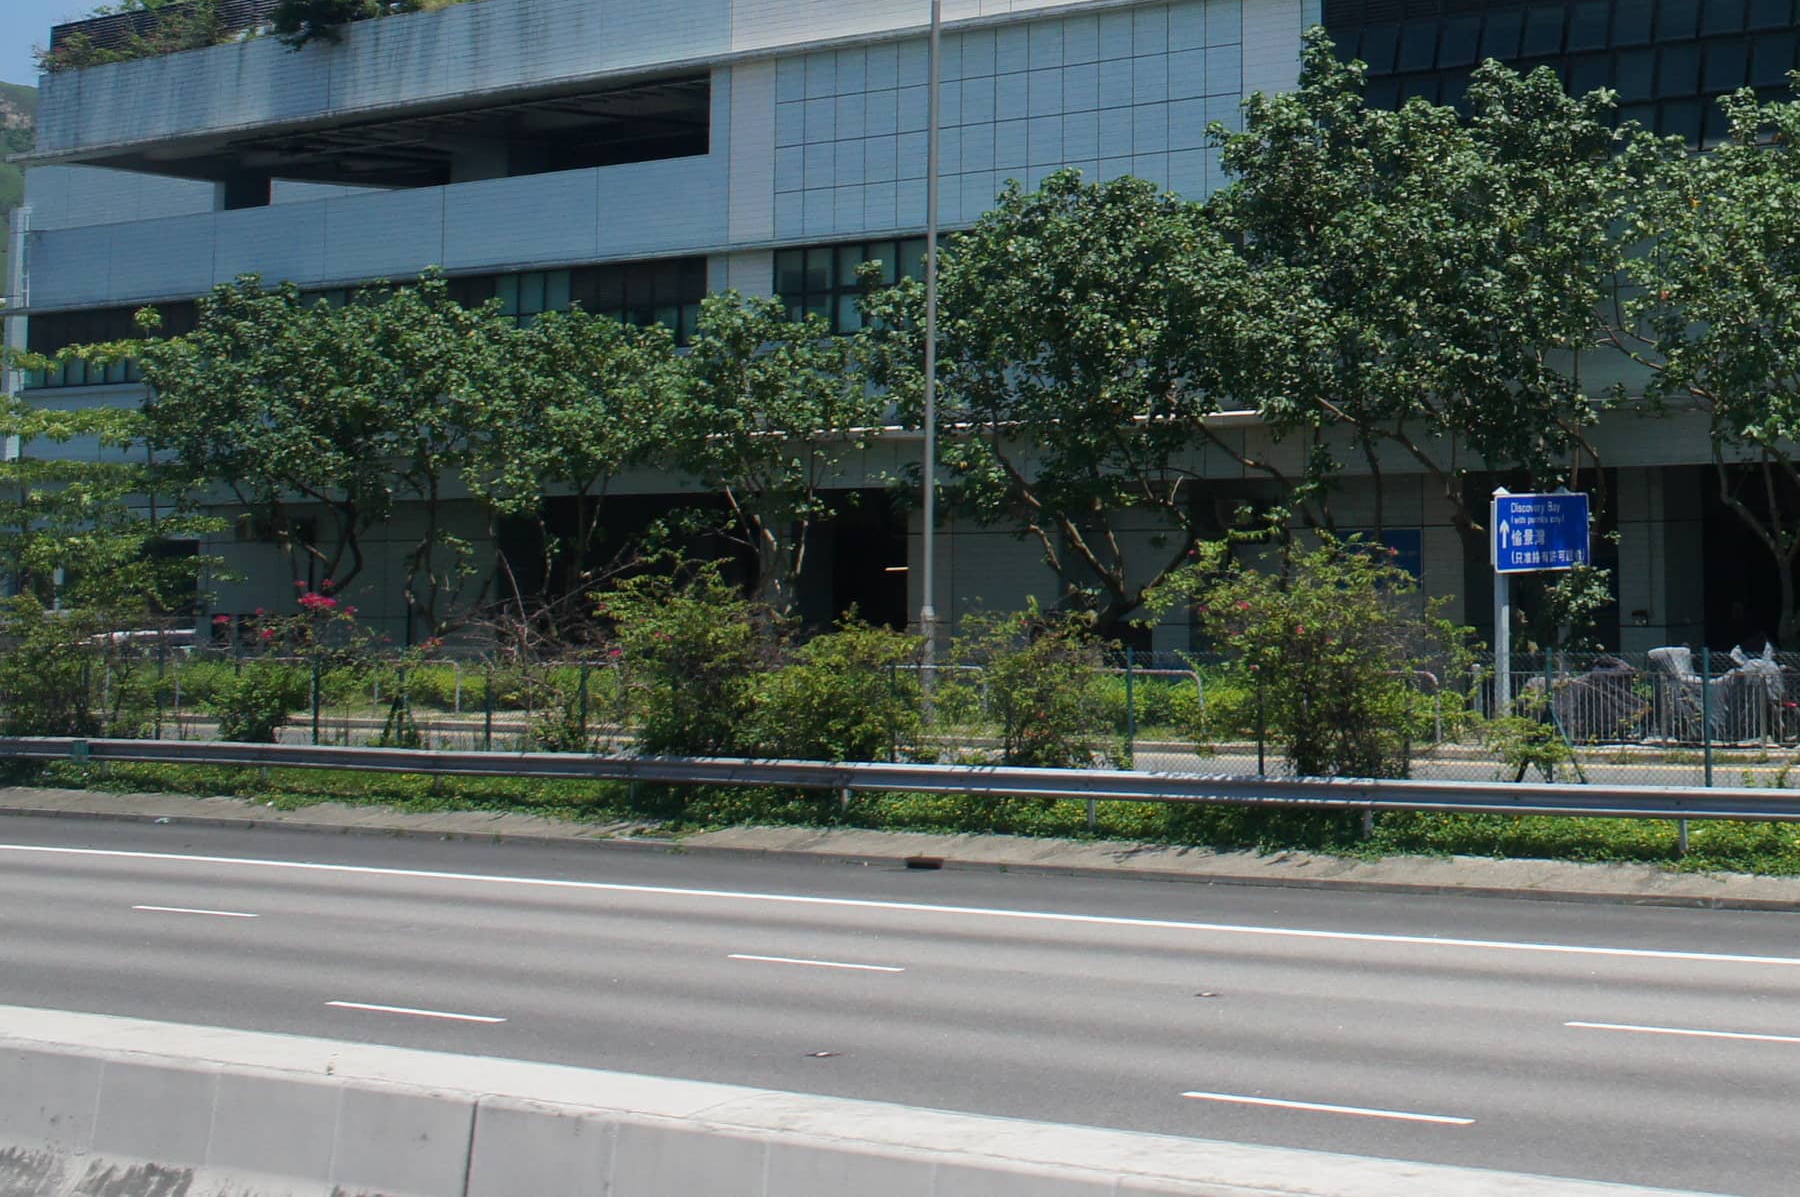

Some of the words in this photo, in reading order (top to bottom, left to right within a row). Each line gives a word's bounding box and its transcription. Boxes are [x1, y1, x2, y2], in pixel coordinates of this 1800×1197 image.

[1511, 502, 1544, 514] Discovery
[1547, 500, 1560, 513] Bay
[1511, 529, 1545, 546] 愉景灣
